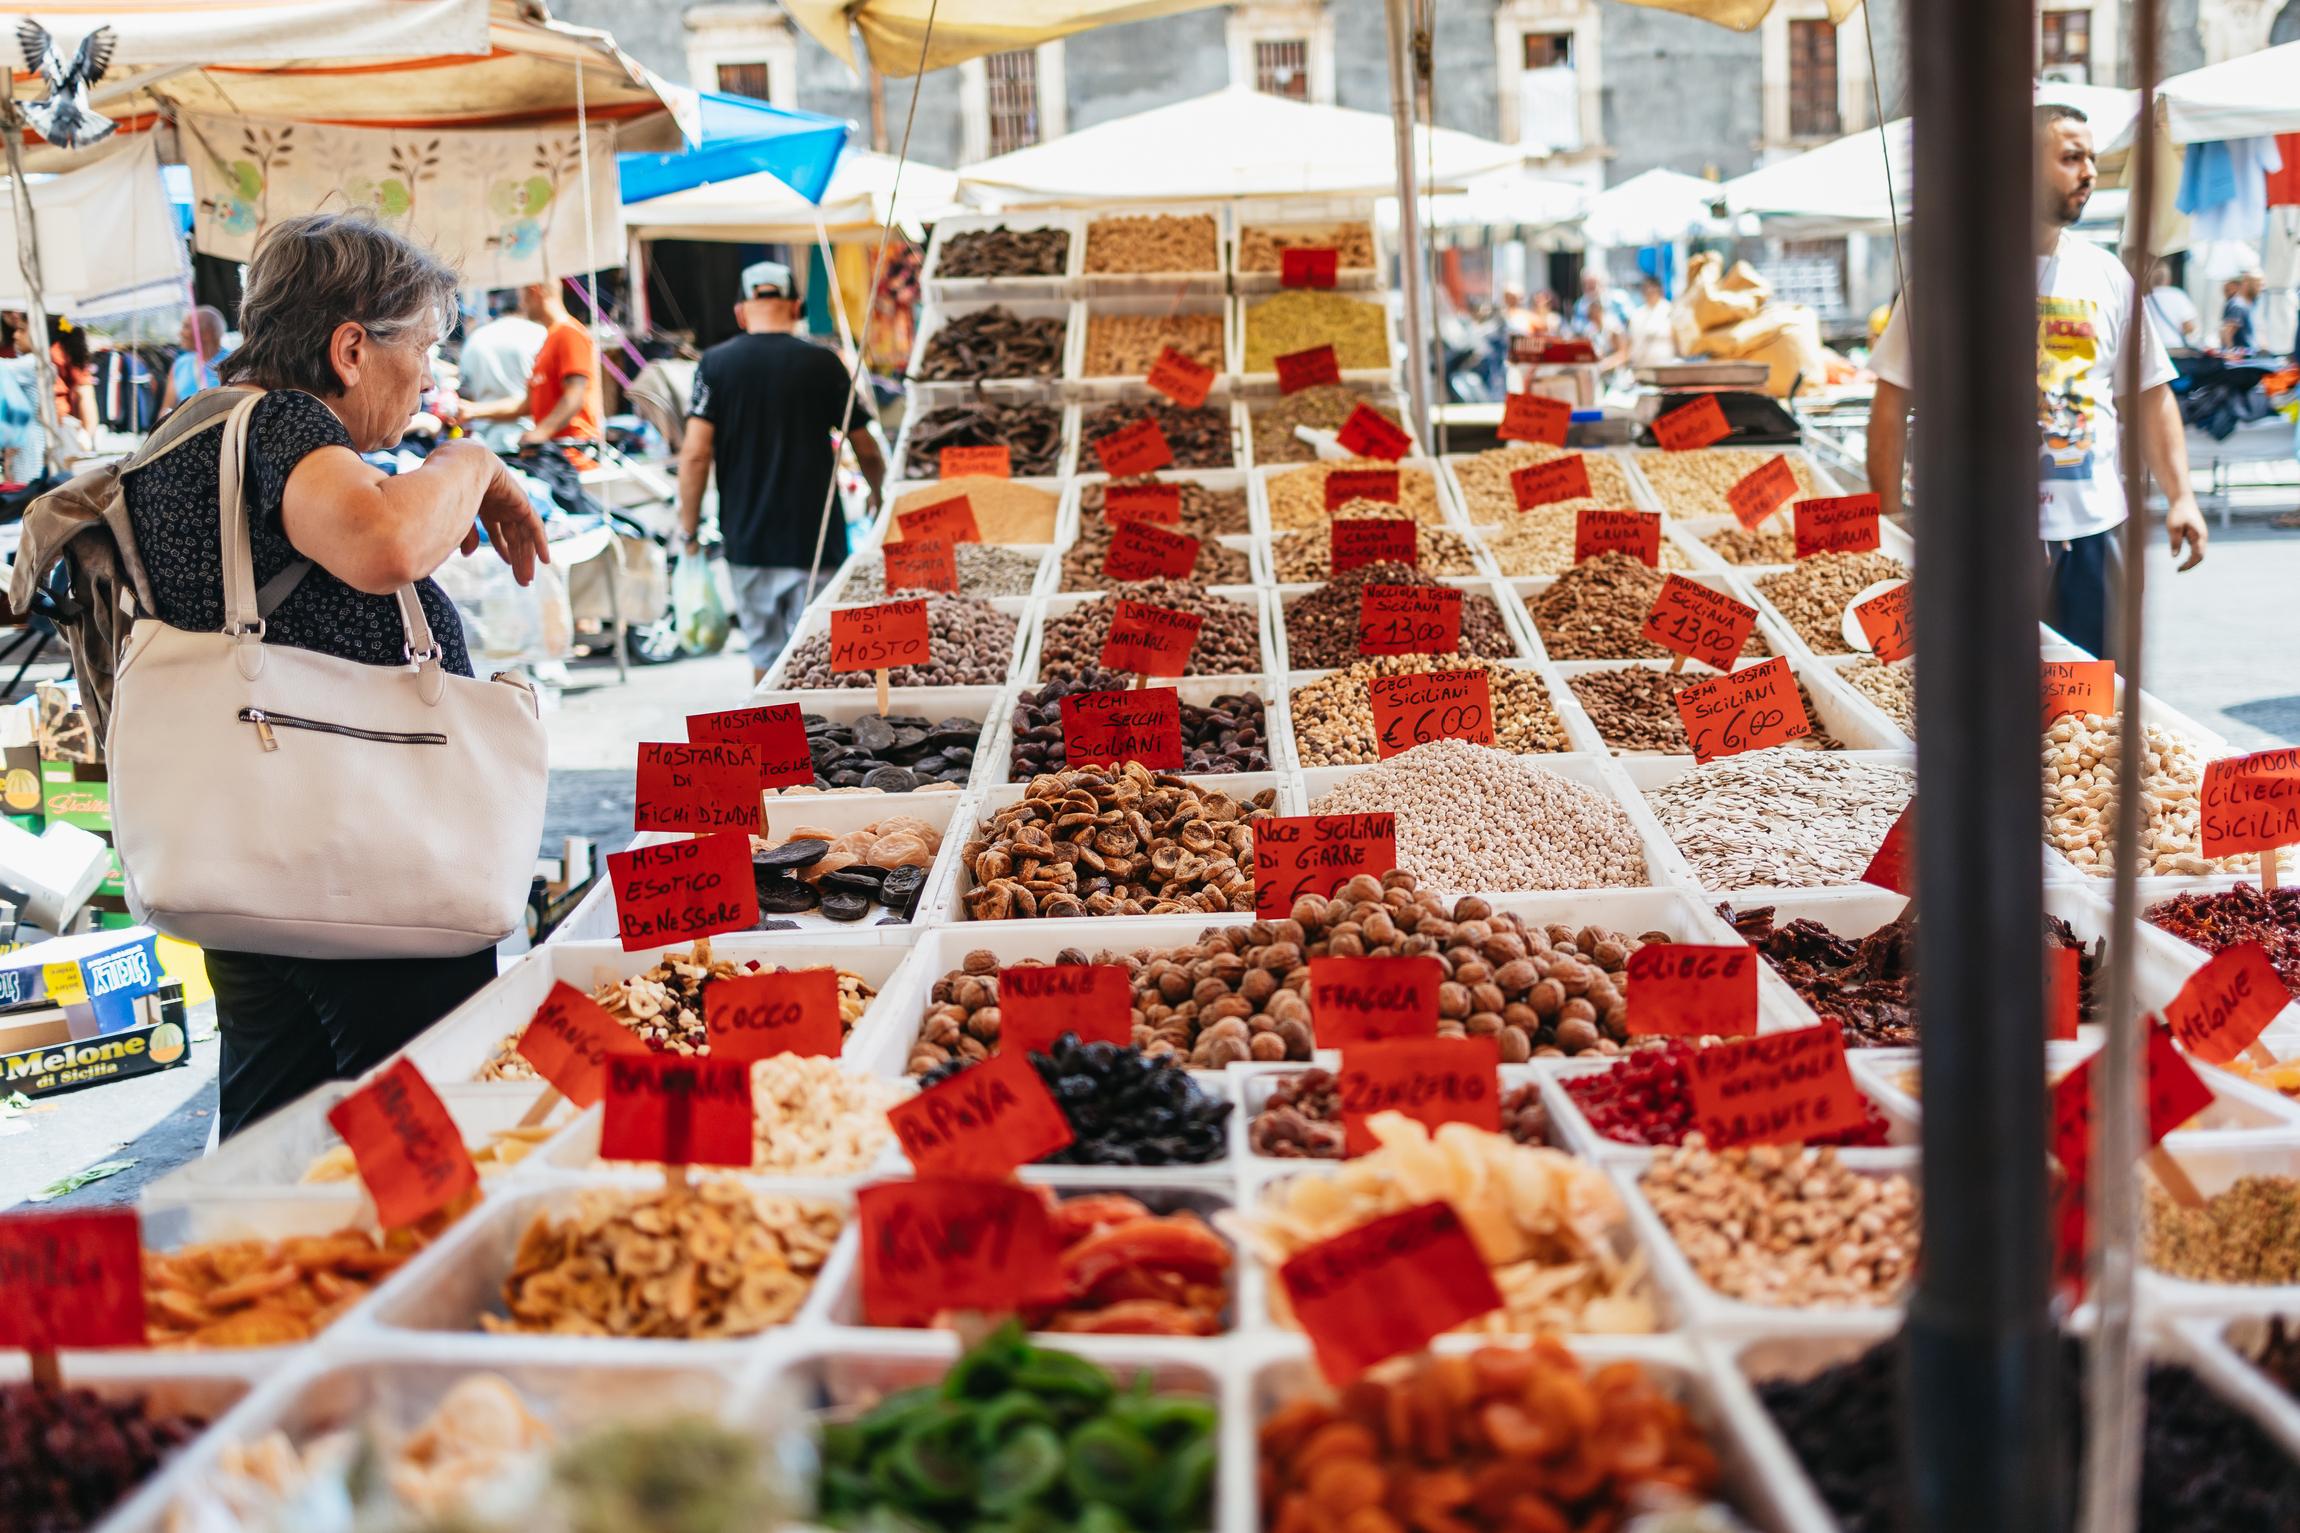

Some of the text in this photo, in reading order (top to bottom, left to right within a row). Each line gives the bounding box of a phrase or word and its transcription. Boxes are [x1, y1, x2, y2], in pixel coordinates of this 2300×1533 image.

[1800, 499, 1837, 514] NOCE
[1366, 585, 1420, 600] NOCCIOLA
[841, 601, 923, 623] MOSTARDA
[1374, 600, 1441, 615] SiCiLiANA
[1668, 591, 1735, 631] SiCiLiANA
[834, 638, 921, 664] MOSTO
[1373, 669, 1488, 695] CECi TOSTATi
[1680, 663, 1779, 707] SEMi TOSTATi
[1387, 685, 1470, 709] SiCiLiANi
[1694, 682, 1778, 720] SiCiLiANi
[710, 708, 794, 730] MOSTARDA
[645, 743, 756, 766] MOSTARDA
[1068, 734, 1162, 760] SiCiLiANi
[759, 755, 811, 778] TOGNE
[672, 773, 692, 788] Di
[638, 803, 689, 824] FiCHi
[1256, 815, 1397, 845] NOCE SiCiLiANA
[631, 844, 699, 872] MiSTO
[1258, 844, 1366, 871] Di GiARRE
[624, 872, 722, 903] ESOTiCO
[709, 1001, 804, 1037] COCCO
[2180, 967, 2252, 1049] MELONE
[5, 1036, 147, 1082] Melone
[35, 1062, 119, 1090] di Sicilia
